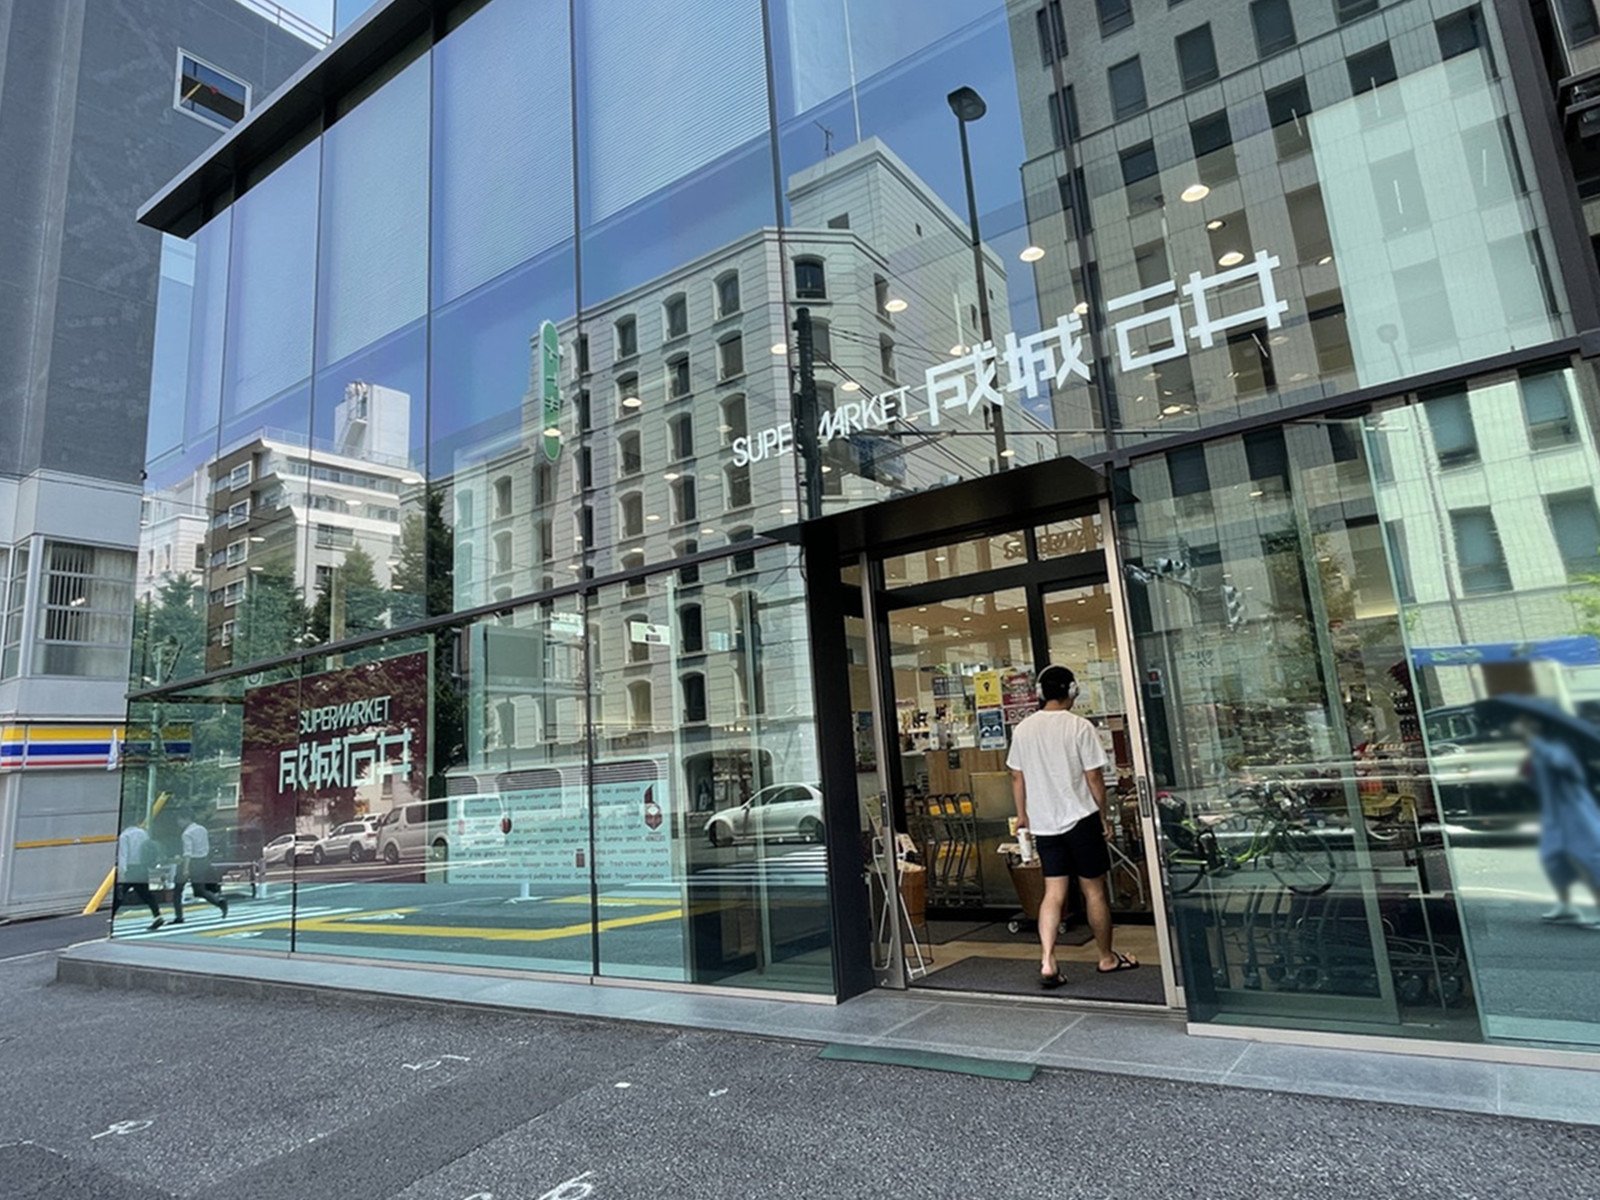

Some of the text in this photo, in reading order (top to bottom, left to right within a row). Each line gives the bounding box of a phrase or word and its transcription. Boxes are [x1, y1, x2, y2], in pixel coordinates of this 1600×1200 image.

[732, 249, 1290, 467] SUPEMARKET 成城石井
[300, 695, 392, 734] SUPERMARKET
[278, 727, 412, 794] 成城石井
